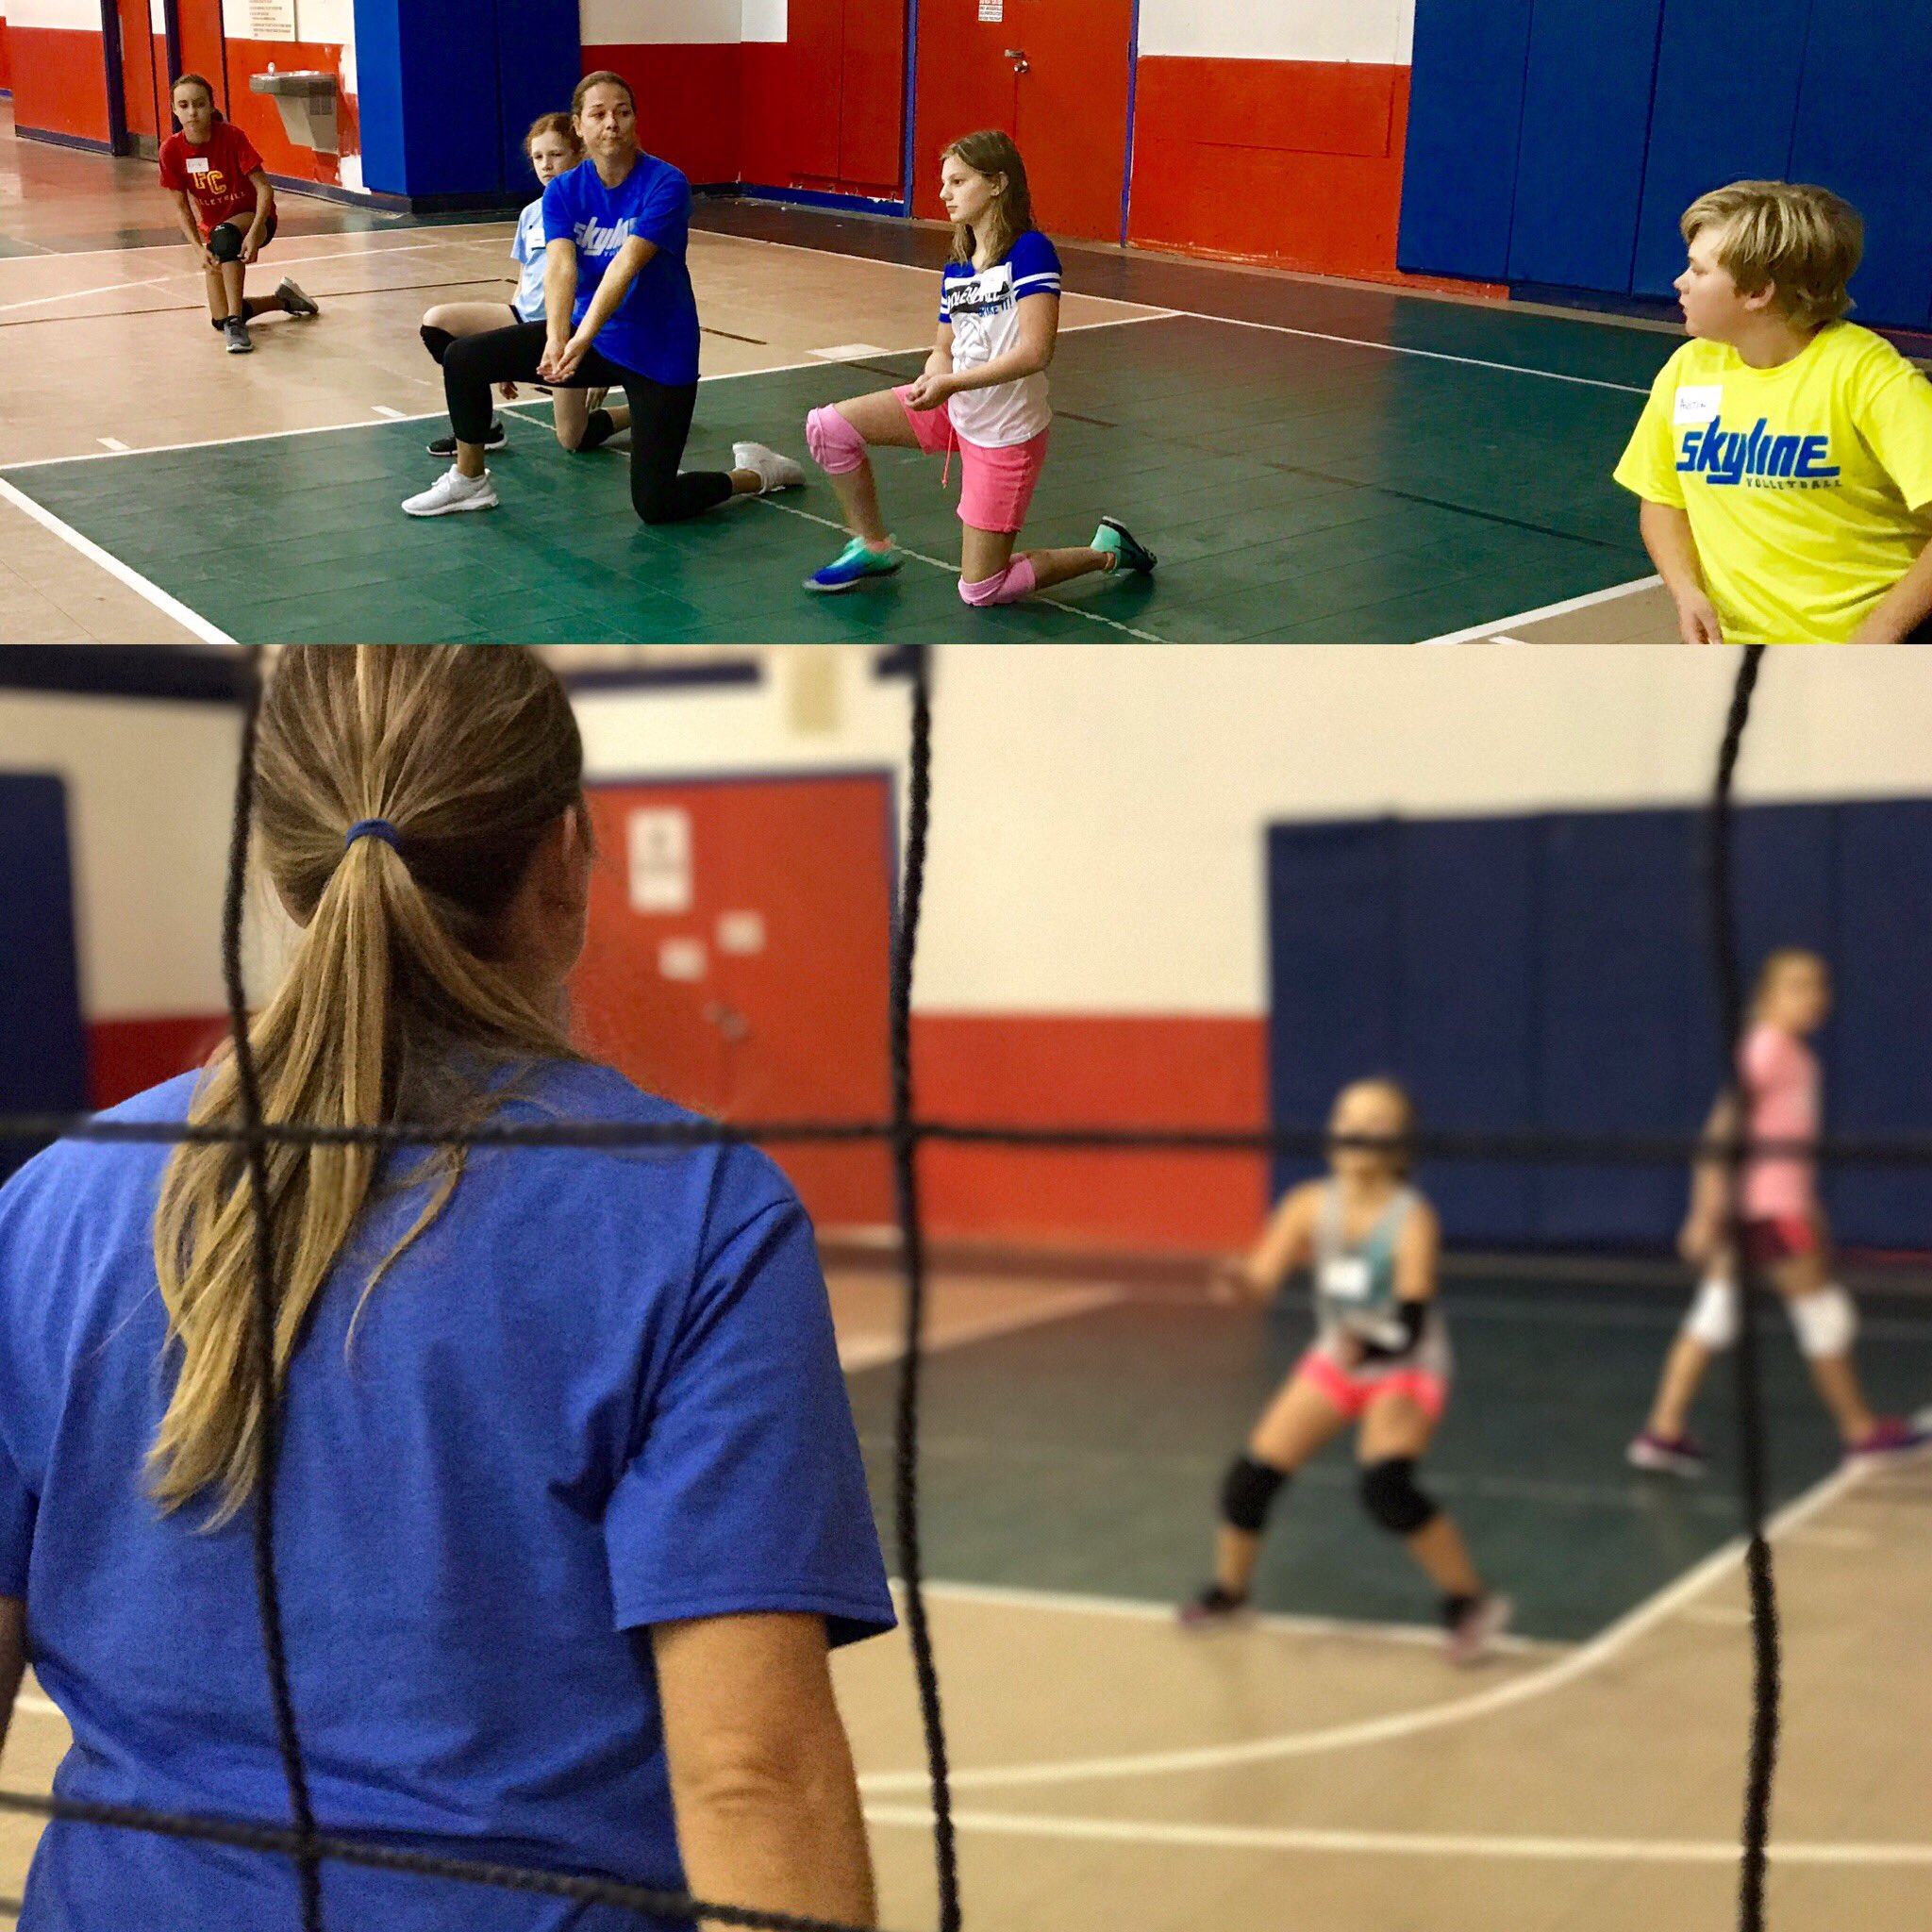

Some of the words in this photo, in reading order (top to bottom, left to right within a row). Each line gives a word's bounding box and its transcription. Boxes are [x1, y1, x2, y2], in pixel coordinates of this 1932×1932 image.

[192, 170, 227, 195] FC
[198, 192, 246, 206] LLEYBALL
[1746, 477, 1842, 491] VOLLEYBALL
